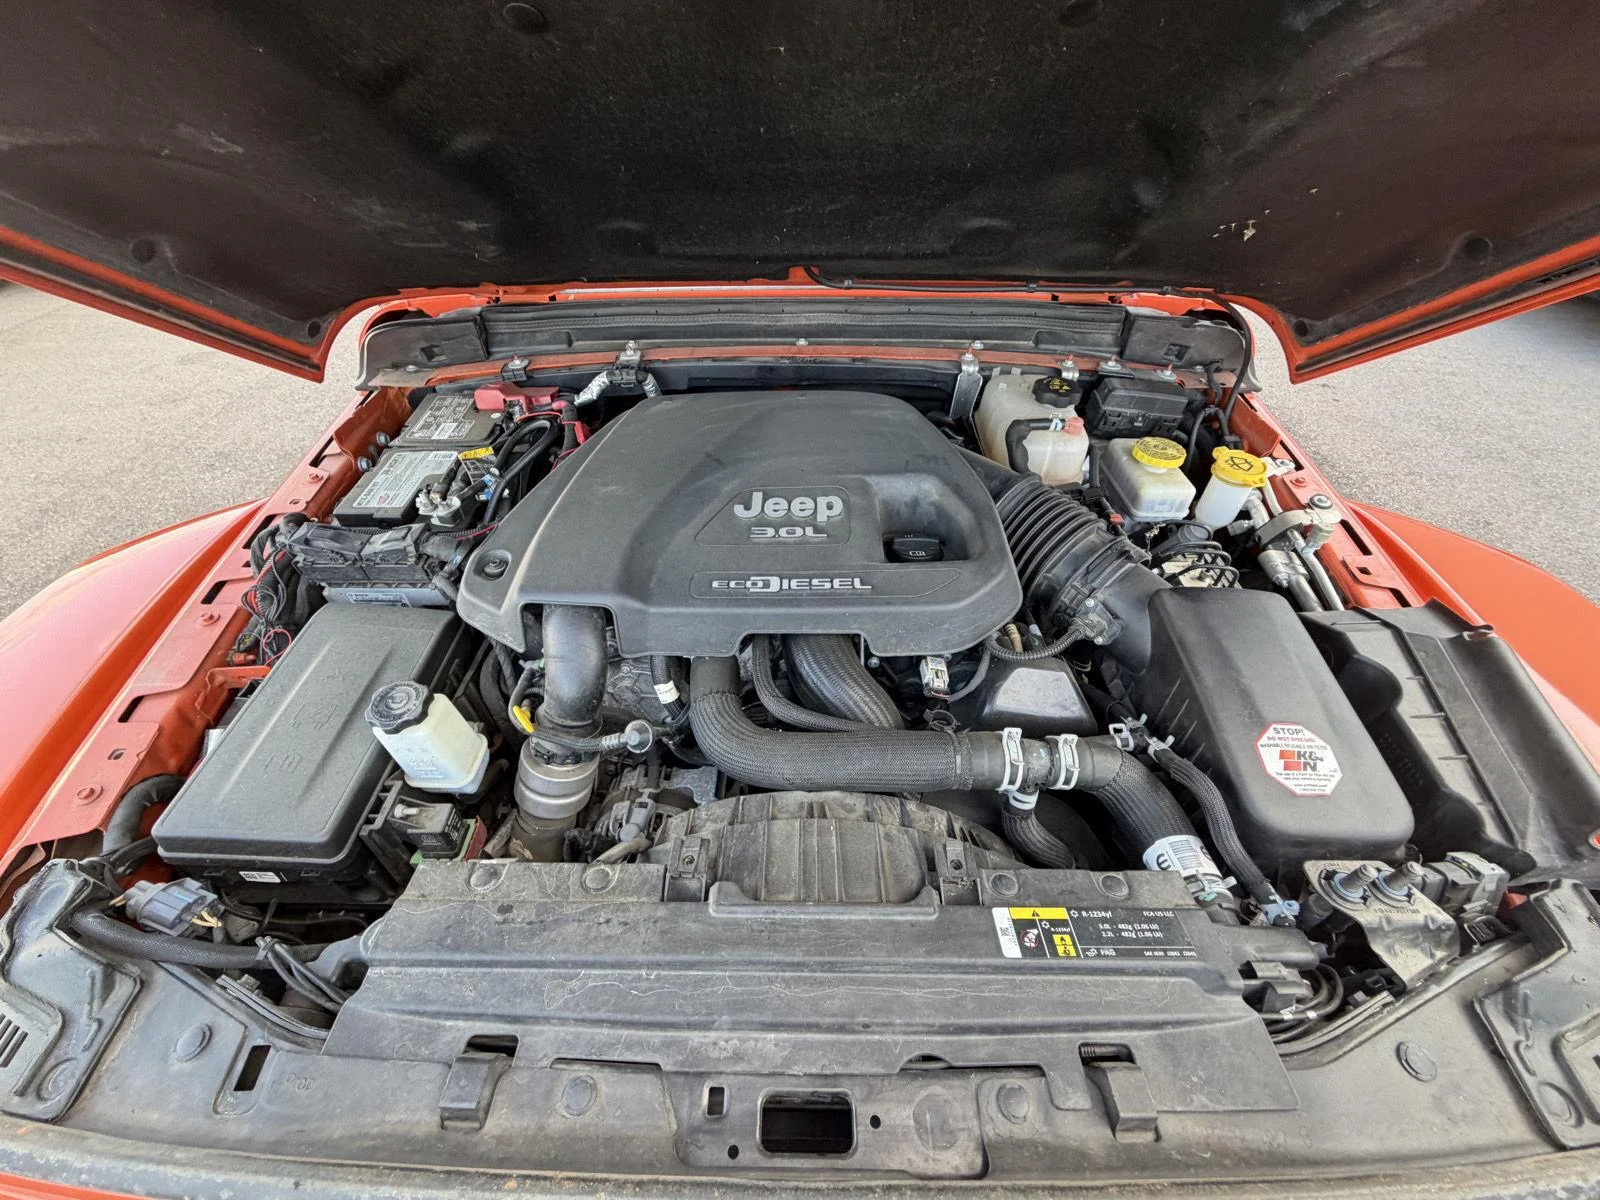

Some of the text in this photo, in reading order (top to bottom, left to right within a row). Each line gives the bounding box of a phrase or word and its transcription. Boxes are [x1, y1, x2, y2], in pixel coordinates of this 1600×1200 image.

[733, 491, 844, 523] Jeep
[750, 526, 828, 539] 3.0L
[1272, 727, 1306, 737] STOP!
[1081, 910, 1113, 919] R-1234yf
